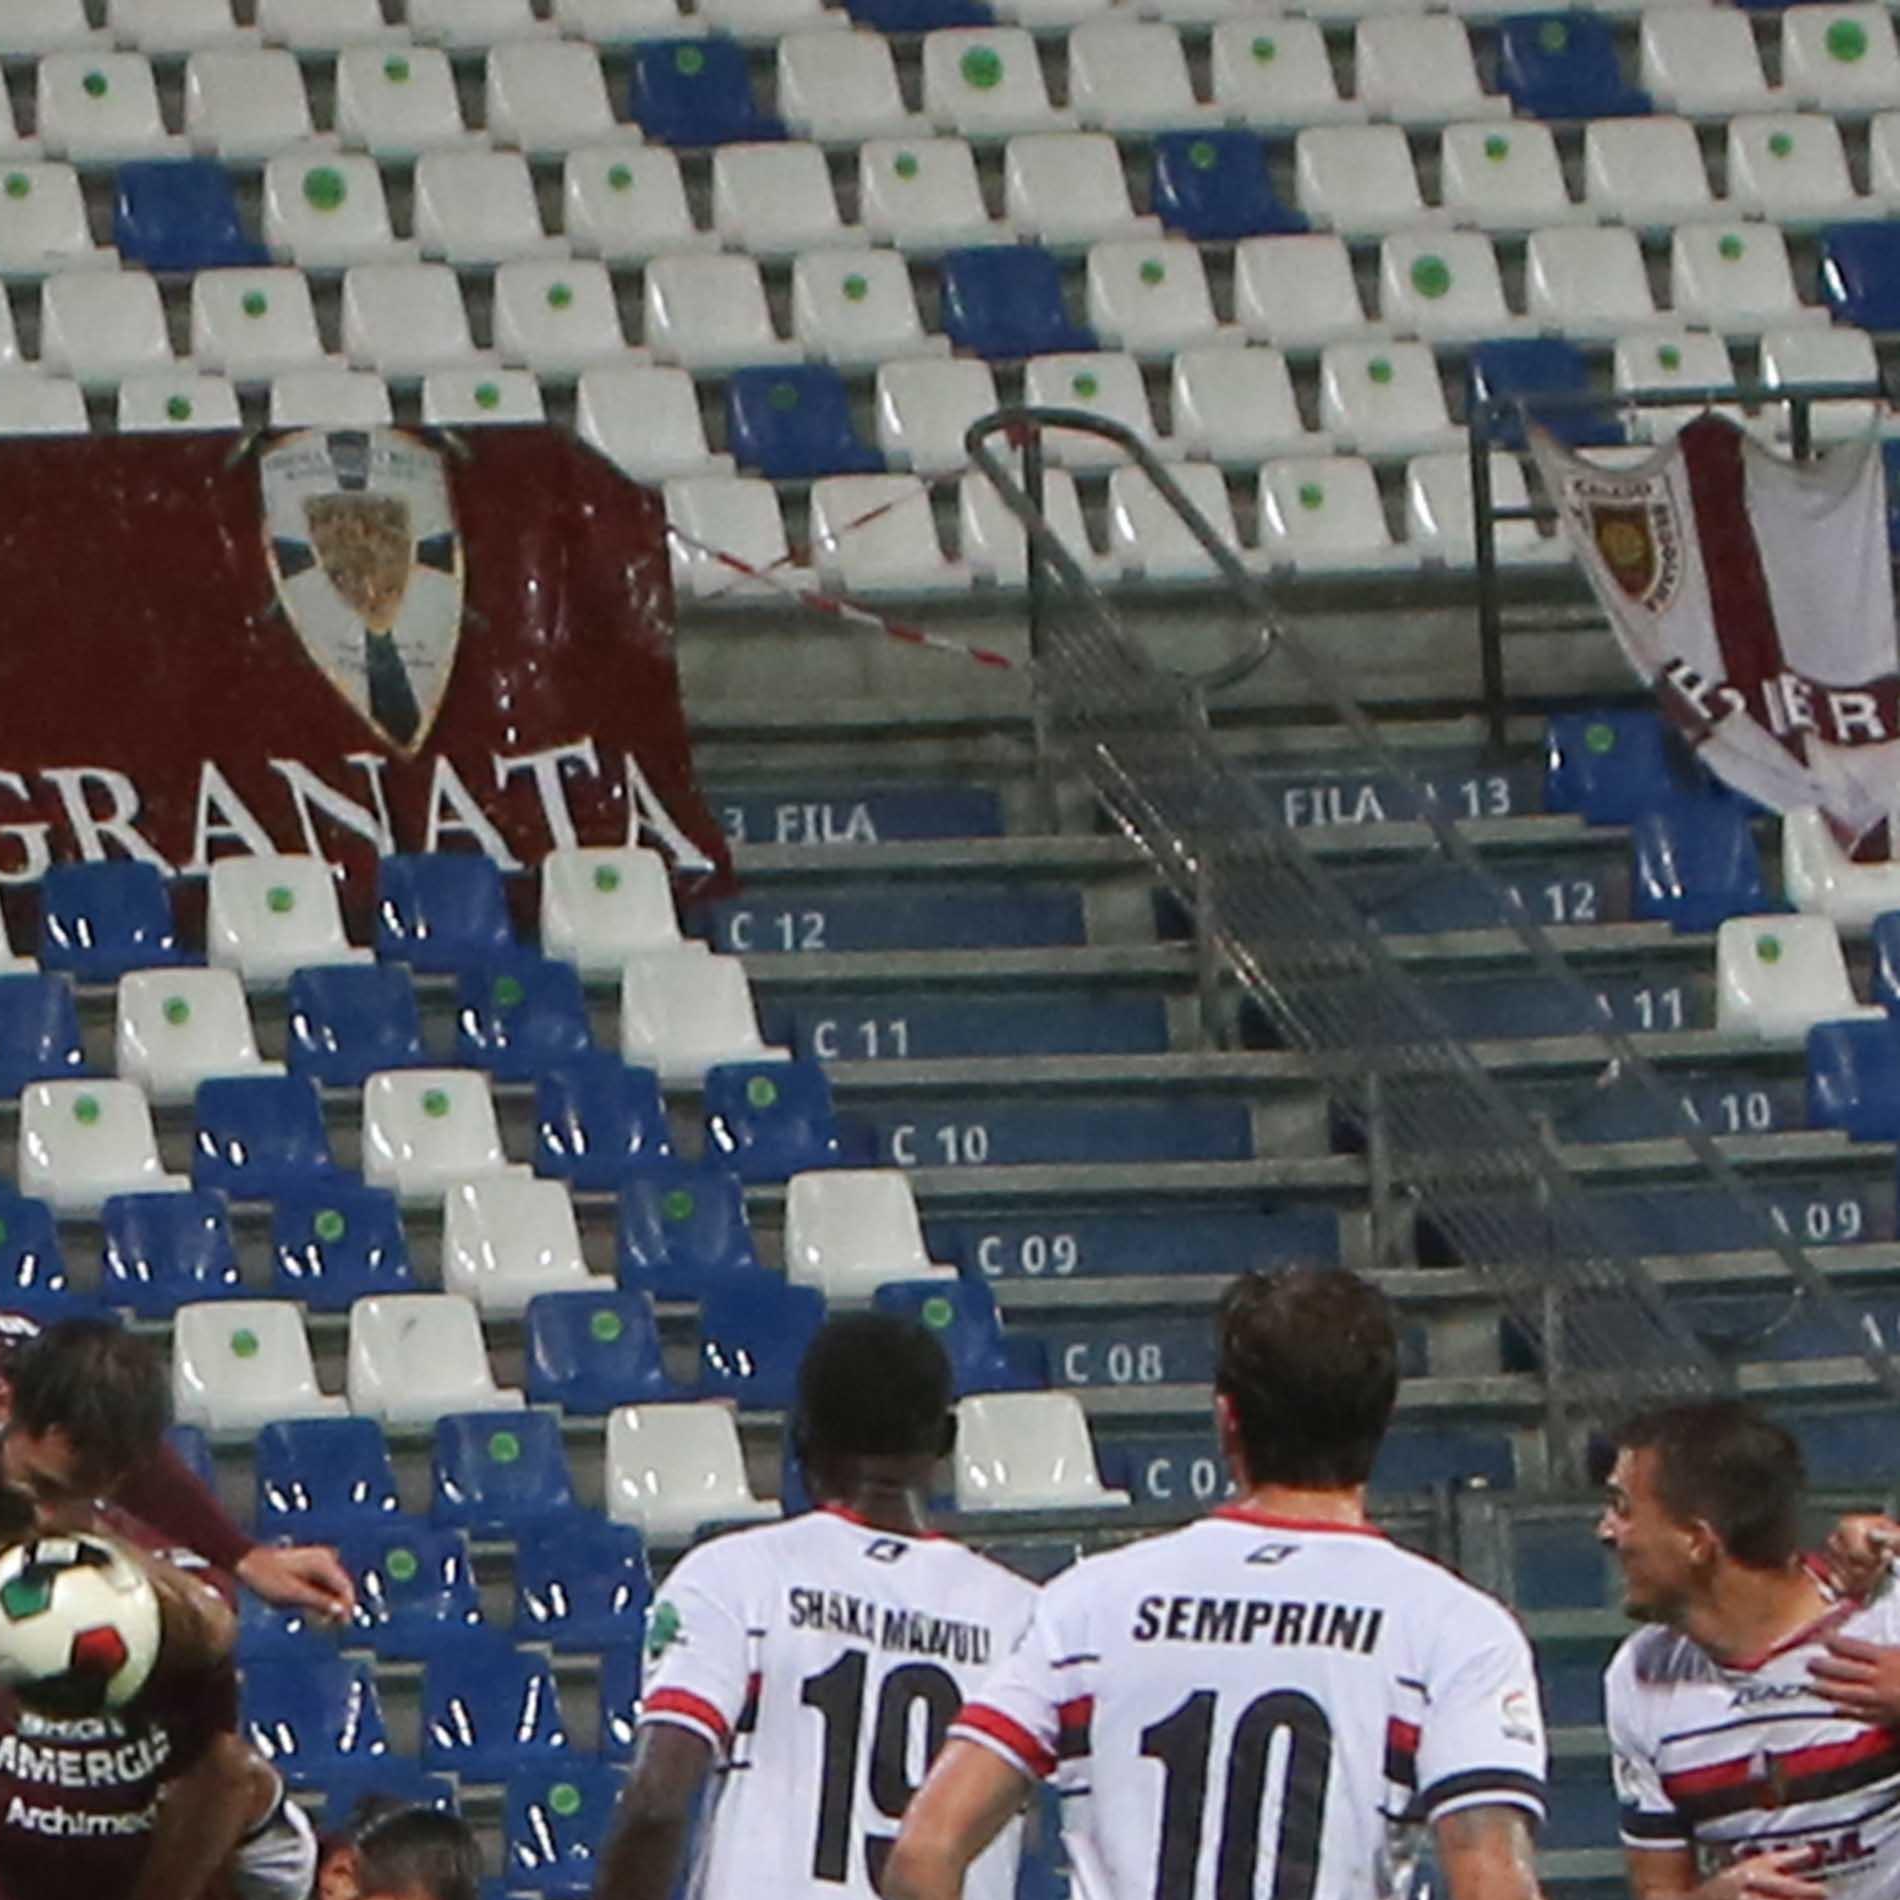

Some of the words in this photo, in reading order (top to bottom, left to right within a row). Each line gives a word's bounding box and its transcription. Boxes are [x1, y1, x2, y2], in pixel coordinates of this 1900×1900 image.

[1284, 786, 1384, 828] FILA
[1459, 776, 1511, 818] 13
[776, 802, 878, 845] FILA
[1546, 881, 1596, 922] 12
[730, 912, 753, 951] C
[776, 912, 826, 952] 12
[1634, 988, 1682, 1030] 11
[814, 1020, 838, 1058] C
[859, 1019, 909, 1058] 11
[1720, 1092, 1770, 1131] 10
[892, 1125, 916, 1164] C
[936, 1125, 989, 1164] 10
[1806, 1201, 1862, 1240] 09
[977, 1236, 1003, 1275] C
[1020, 1234, 1077, 1275] 09
[1064, 1344, 1089, 1383] C
[1107, 1343, 1163, 1382] 08
[1147, 1458, 1172, 1498] C
[1191, 1458, 1236, 1499] 0
[1133, 1595, 1384, 1656] SEMPRINI
[802, 1647, 965, 1897] 19
